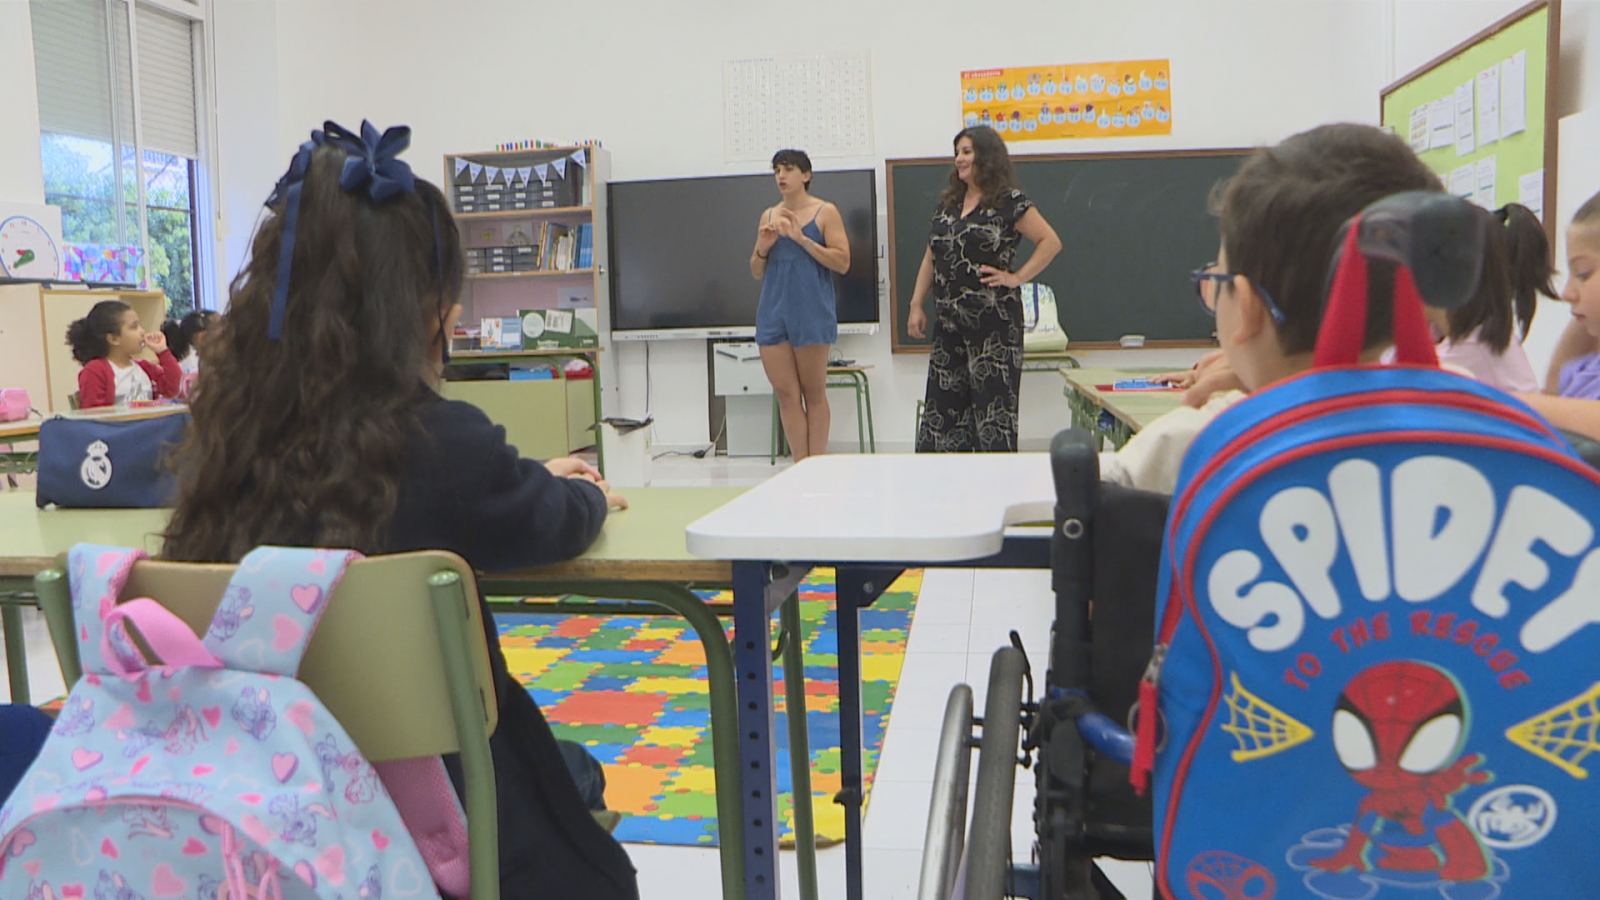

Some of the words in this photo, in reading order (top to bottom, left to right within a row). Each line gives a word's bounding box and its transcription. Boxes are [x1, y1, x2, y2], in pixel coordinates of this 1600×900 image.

[1207, 455, 1600, 653] SPIDEY
[1284, 653, 1321, 690] TO
[1330, 611, 1389, 653] THE
[1409, 609, 1531, 690] RESCUE
